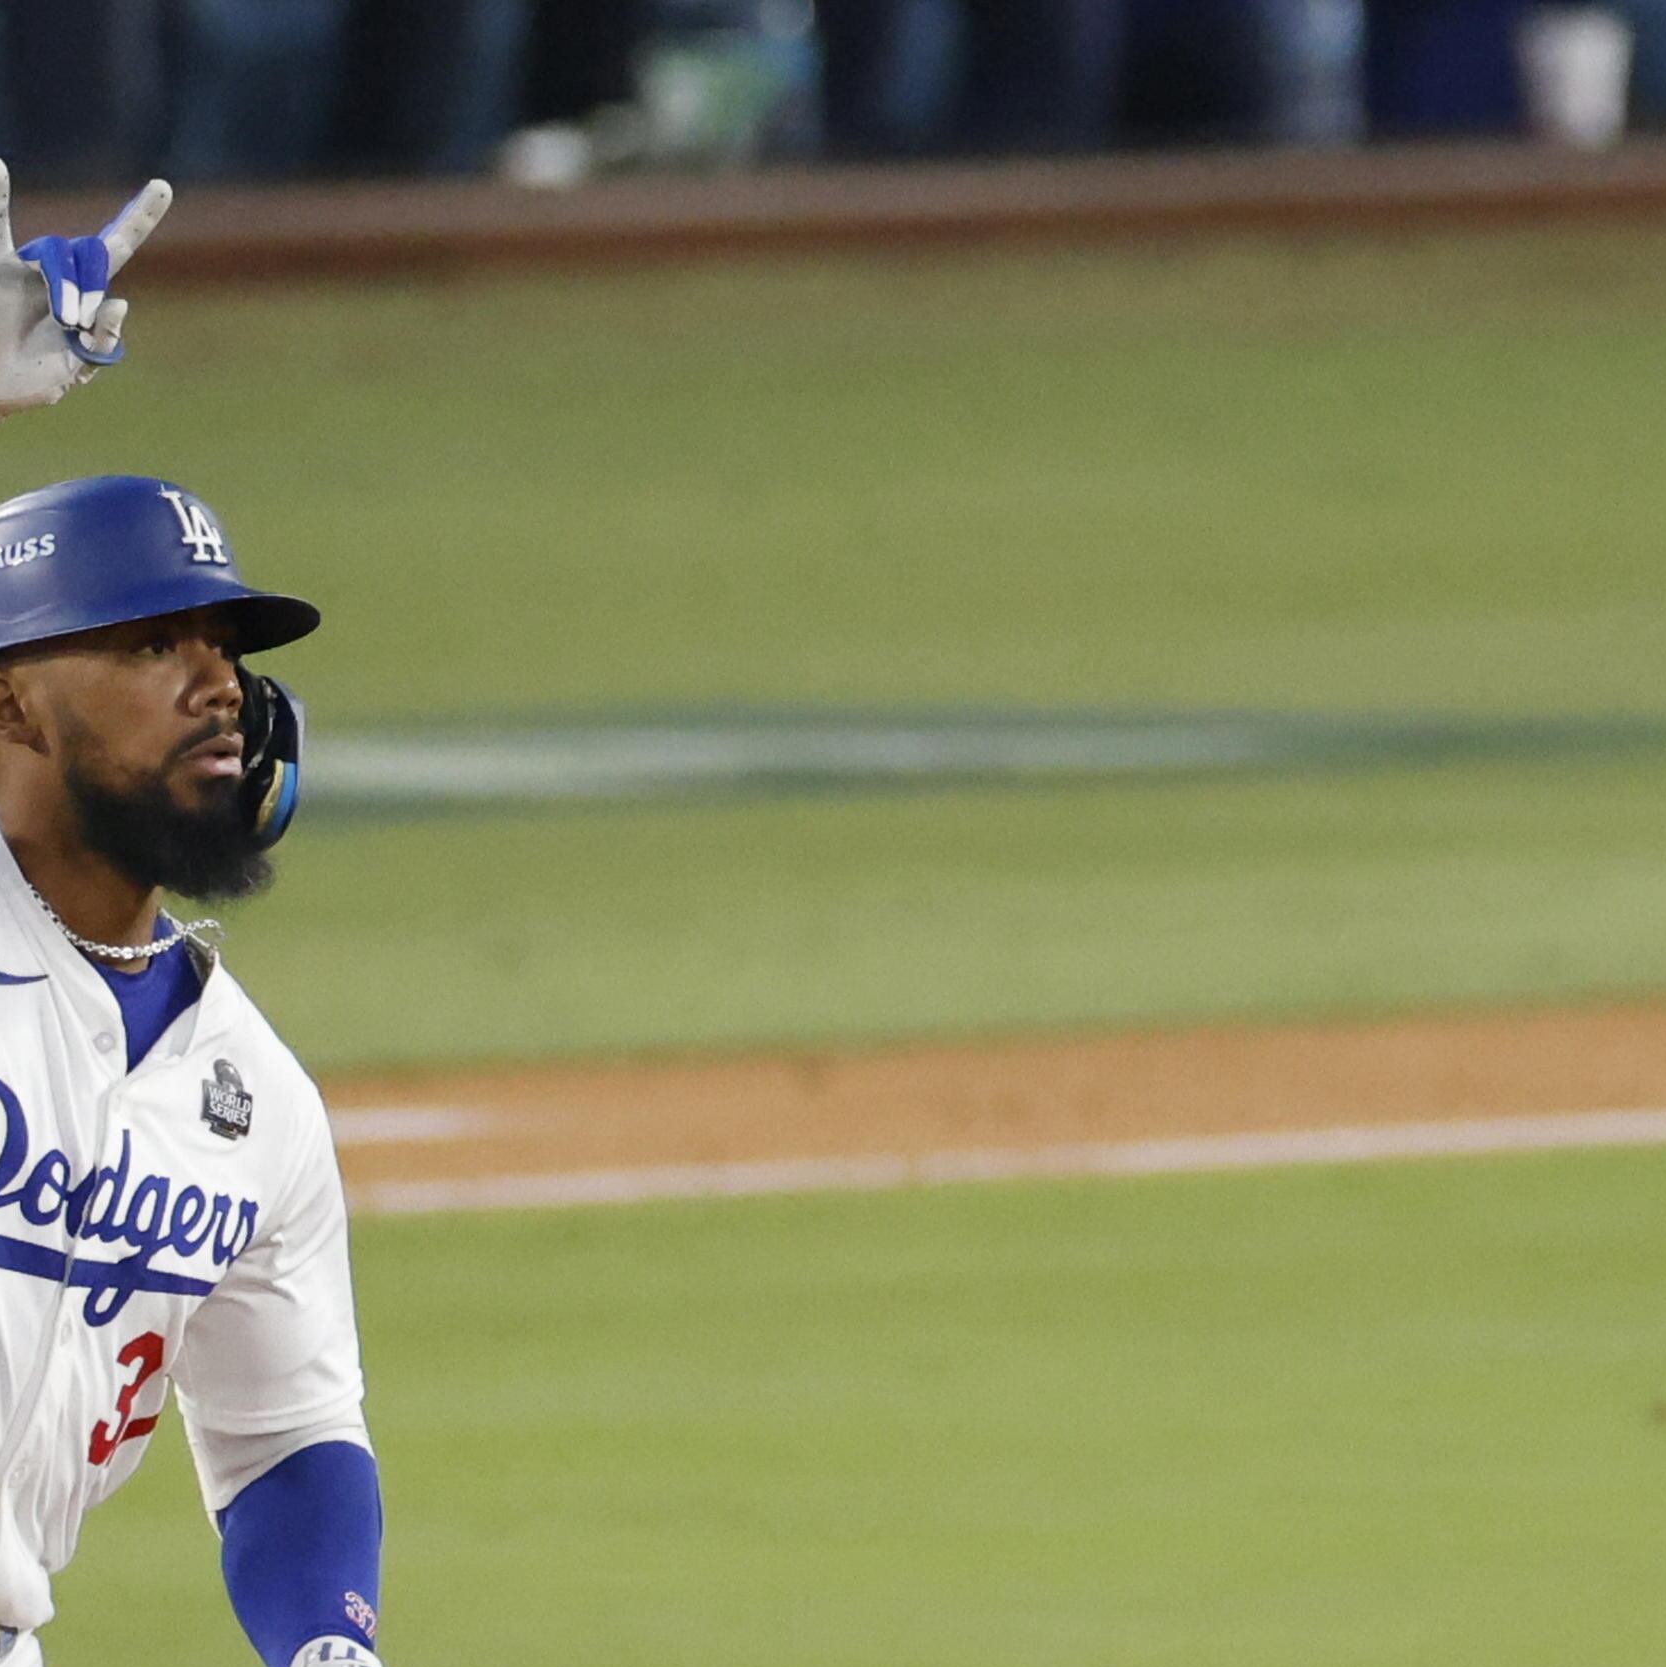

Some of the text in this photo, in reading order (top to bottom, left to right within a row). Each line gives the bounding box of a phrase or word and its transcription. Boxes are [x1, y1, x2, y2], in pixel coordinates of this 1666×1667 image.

[158, 484, 230, 565] LA
[209, 1086, 251, 1113] WORLD
[209, 1101, 248, 1127] SERIES
